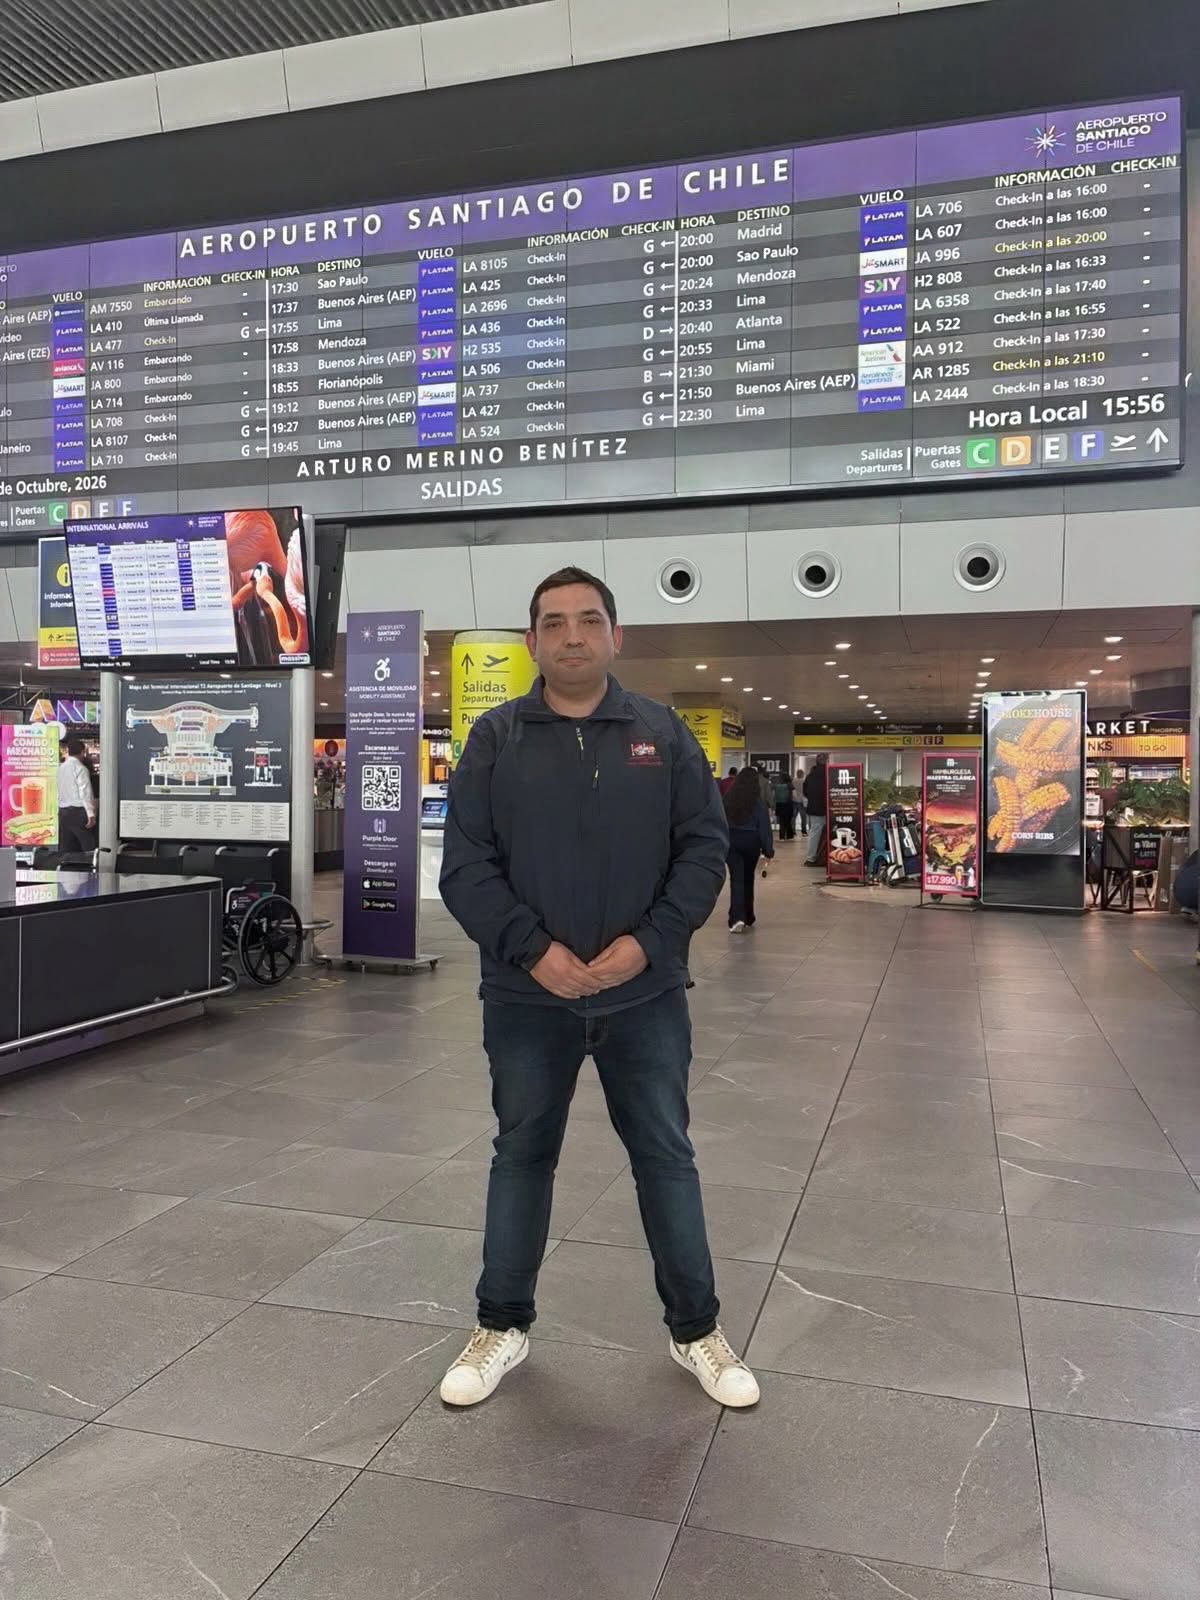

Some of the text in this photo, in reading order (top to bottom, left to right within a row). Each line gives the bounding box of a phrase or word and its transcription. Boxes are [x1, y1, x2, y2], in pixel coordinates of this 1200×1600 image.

[1076, 112, 1166, 132] AEROPUERTO
[1076, 122, 1151, 144] SANTIAGO
[1076, 136, 1135, 153] DE CHILE
[681, 155, 1179, 229] HORA DESTINO VUELO INFORMACIÓN CHECK-IN
[180, 159, 788, 258] AEROPUERTO SANTIAGO DE CHILE
[680, 183, 1107, 247] 20:00 Madrid LATAM LA 706 Check-In a las 16:00
[271, 220, 675, 277] HORA DESTINO VUELO INFORMACIÓN CHECK-IN
[680, 276, 713, 291] 20:24
[737, 268, 796, 284] Mendoza
[915, 251, 931, 264] JA
[935, 247, 960, 261] 996
[995, 239, 1042, 253] Check-In
[1046, 239, 1053, 247] a
[1056, 236, 1071, 246] las
[1075, 231, 1107, 244] 20:00
[272, 282, 298, 294] 17:30
[317, 278, 336, 289] Sao
[339, 274, 368, 287] Paulo
[463, 261, 477, 273] LA
[481, 257, 507, 271] 8105
[527, 252, 566, 264] Check-In
[643, 239, 654, 253] G
[52, 269, 265, 303] VUELO INFORMACIÓN CHECK-IN
[272, 279, 501, 314] 17:37 Buenos Aires (AEP) LA 425
[90, 295, 192, 314] AM 7550 Embarcando
[680, 293, 970, 335] 20:40 Atlanta LA 6358
[91, 323, 103, 333] LA
[105, 320, 122, 331] 410
[272, 316, 565, 354] 17:58 Mendoza LA 436 Check-In
[90, 353, 192, 372] AV 116 Embarcando
[679, 327, 1106, 379] 21:30 Miami AA 912 Check-In a las 17:30
[272, 363, 501, 393] 18:55 Florianópolis LA 506
[679, 387, 712, 400] 21:50
[736, 383, 781, 395] Buenos
[784, 378, 816, 391] Aires
[820, 373, 855, 390] (AEP)
[912, 367, 933, 380] AR
[937, 363, 970, 377] 1285
[969, 393, 1165, 428] Hora Local 15:56
[272, 425, 500, 453] 19:45 Lima LA 524
[861, 433, 1096, 464] Salidas Puertas C D E F
[297, 438, 626, 477] ARTURO MERINO BENÍTEZ
[846, 459, 961, 476] Departures Gates
[0, 475, 107, 495] de Octubre, 2026
[421, 478, 502, 500] SALIDAS
[15, 506, 46, 515] Puertas
[53, 505, 64, 523] C
[15, 518, 35, 526] Gates
[67, 521, 149, 532] INTERNATIONAL ARRIVALS
[462, 695, 508, 703] Departures
[463, 681, 506, 693] Salidas
[362, 835, 382, 843] Purple
